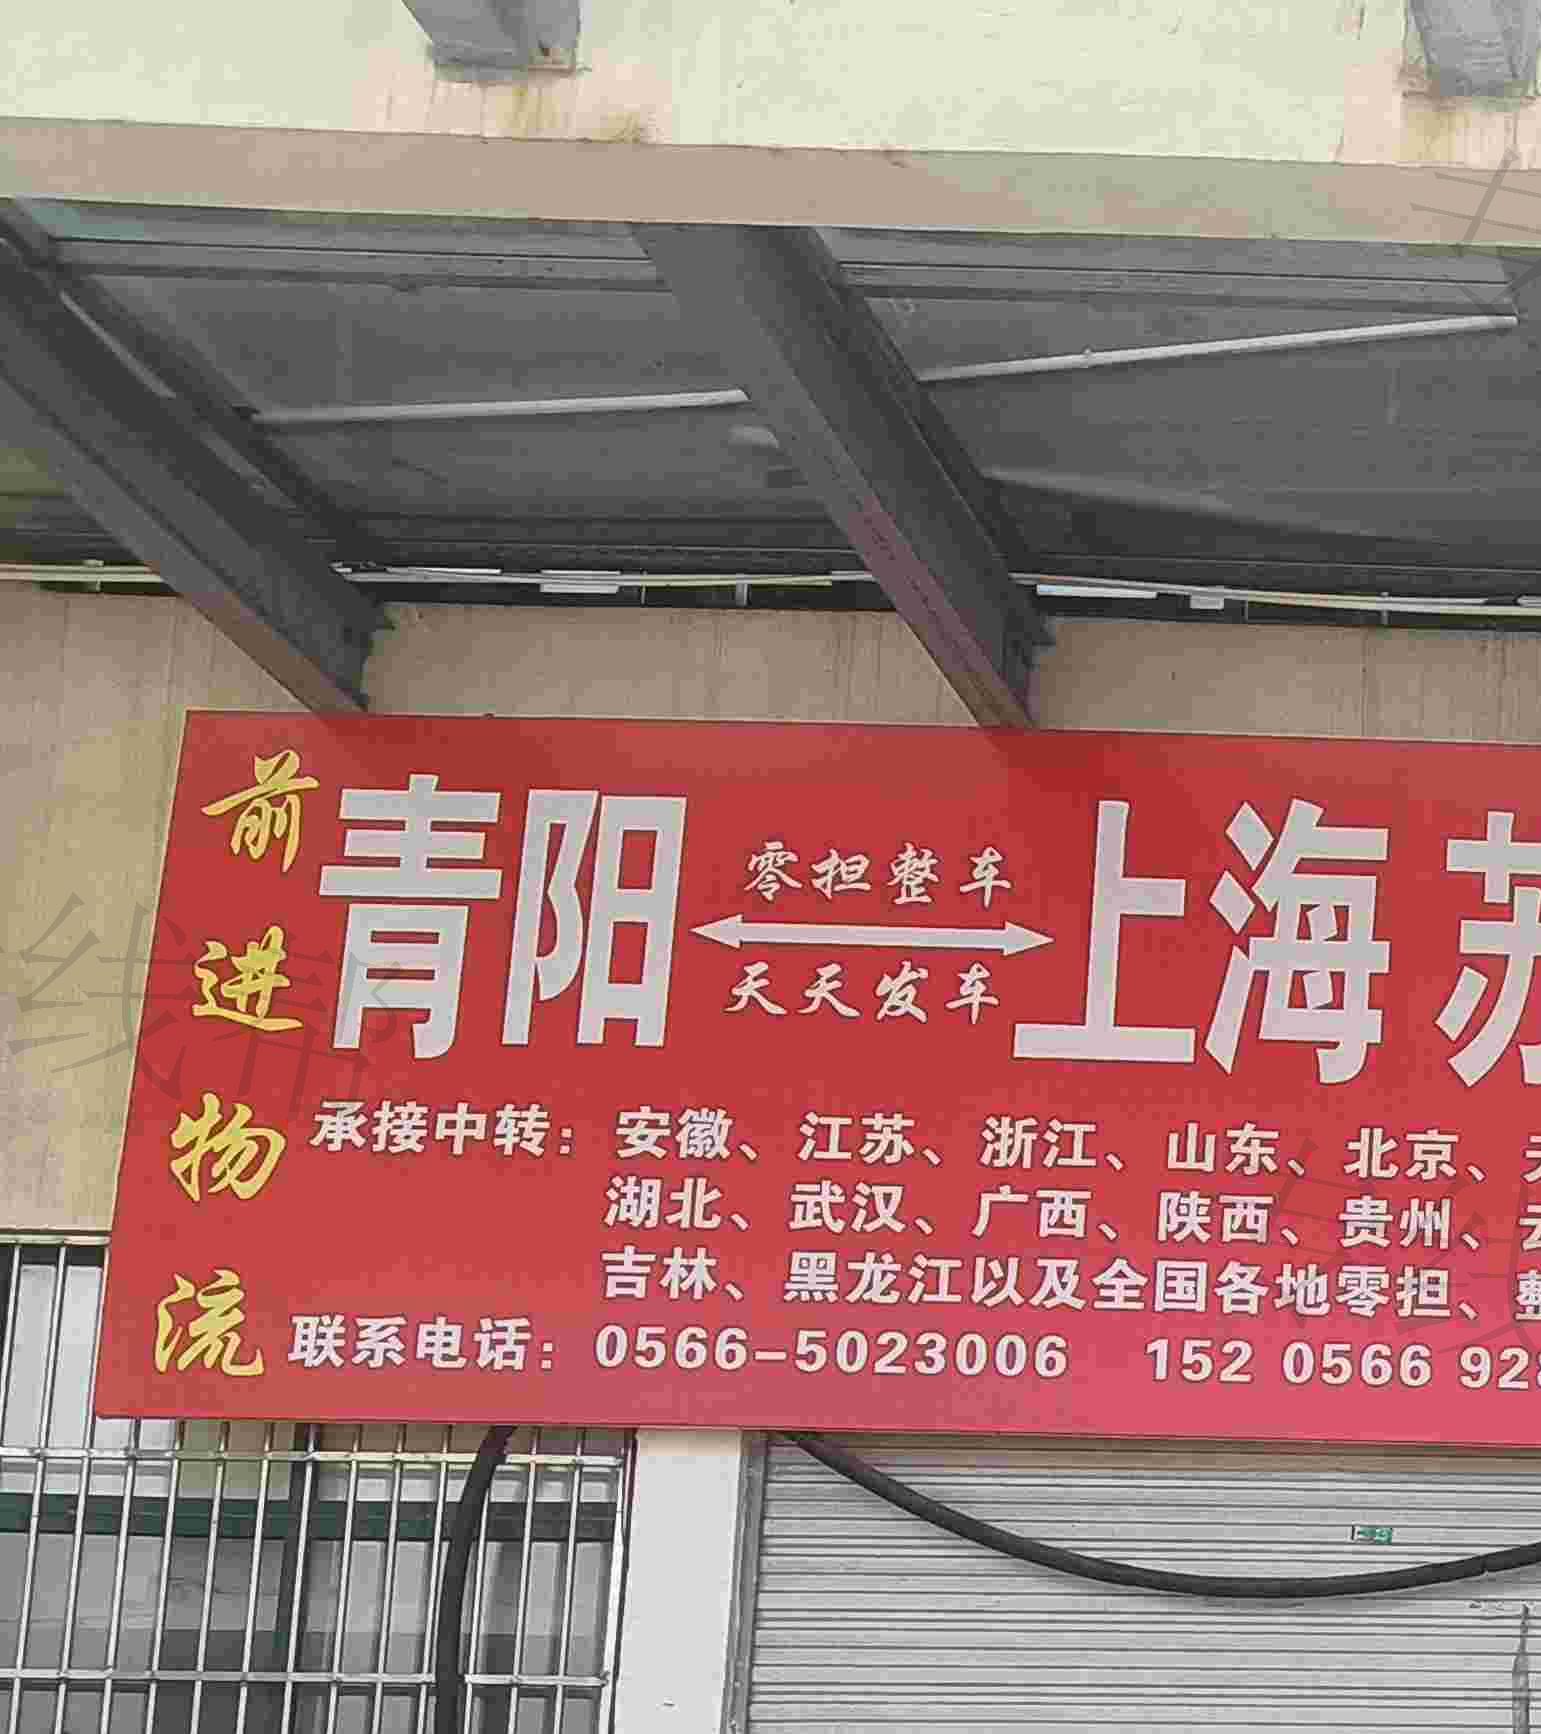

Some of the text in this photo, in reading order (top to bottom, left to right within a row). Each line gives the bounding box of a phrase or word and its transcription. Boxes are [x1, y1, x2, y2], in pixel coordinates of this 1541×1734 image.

[744, 840, 1013, 908] 零担整车
[318, 774, 688, 1060] 青阳
[1011, 798, 1391, 1084] 上海
[724, 959, 1002, 1025] 天天发车
[150, 751, 320, 1378] 前进物流
[1145, 1339, 1253, 1383] 152
[1282, 1342, 1432, 1387] 0566
